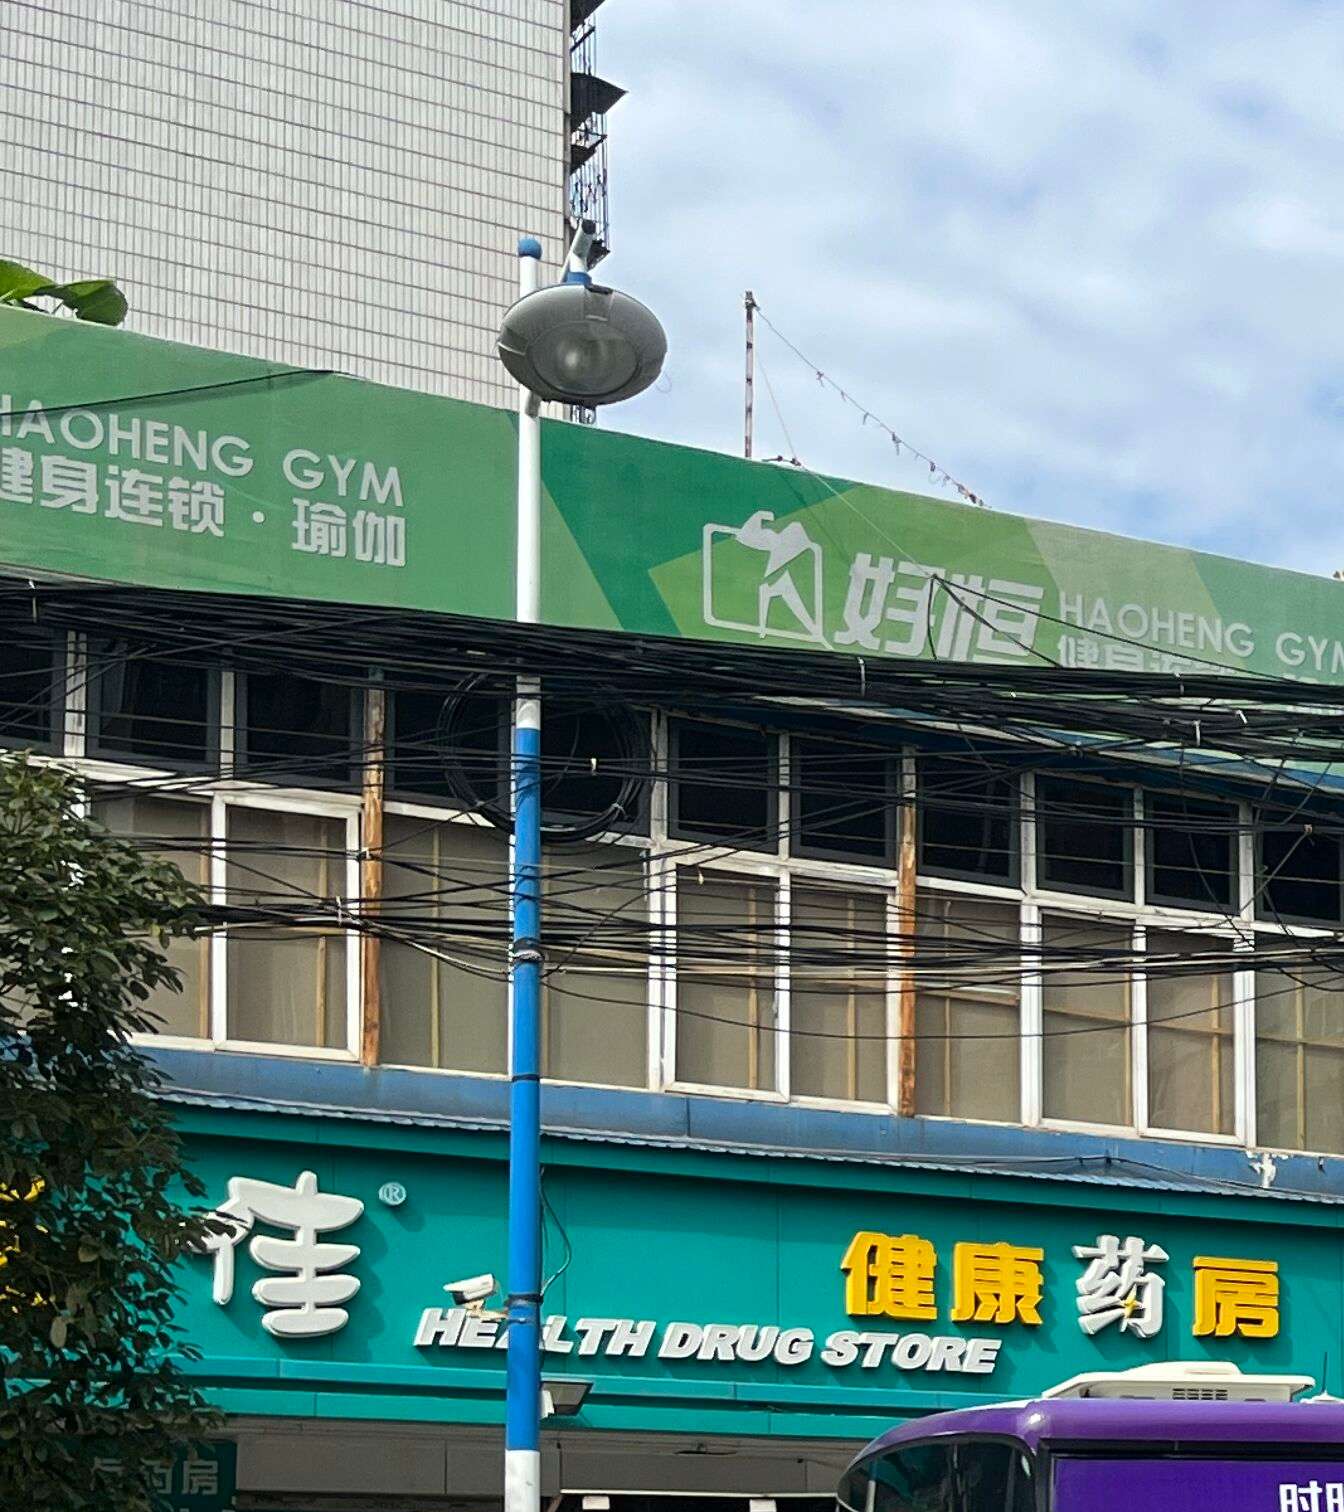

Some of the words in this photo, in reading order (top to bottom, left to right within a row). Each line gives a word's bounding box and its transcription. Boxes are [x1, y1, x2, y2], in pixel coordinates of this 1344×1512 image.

[282, 449, 404, 506] GYM
[1058, 590, 1255, 658] HAOHENG
[180, 1170, 364, 1338] 佳
[840, 1230, 1280, 1340] 健康药房
[413, 1307, 654, 1358] HELTH
[657, 1322, 815, 1366] DRUG
[820, 1331, 1002, 1374] STORE
